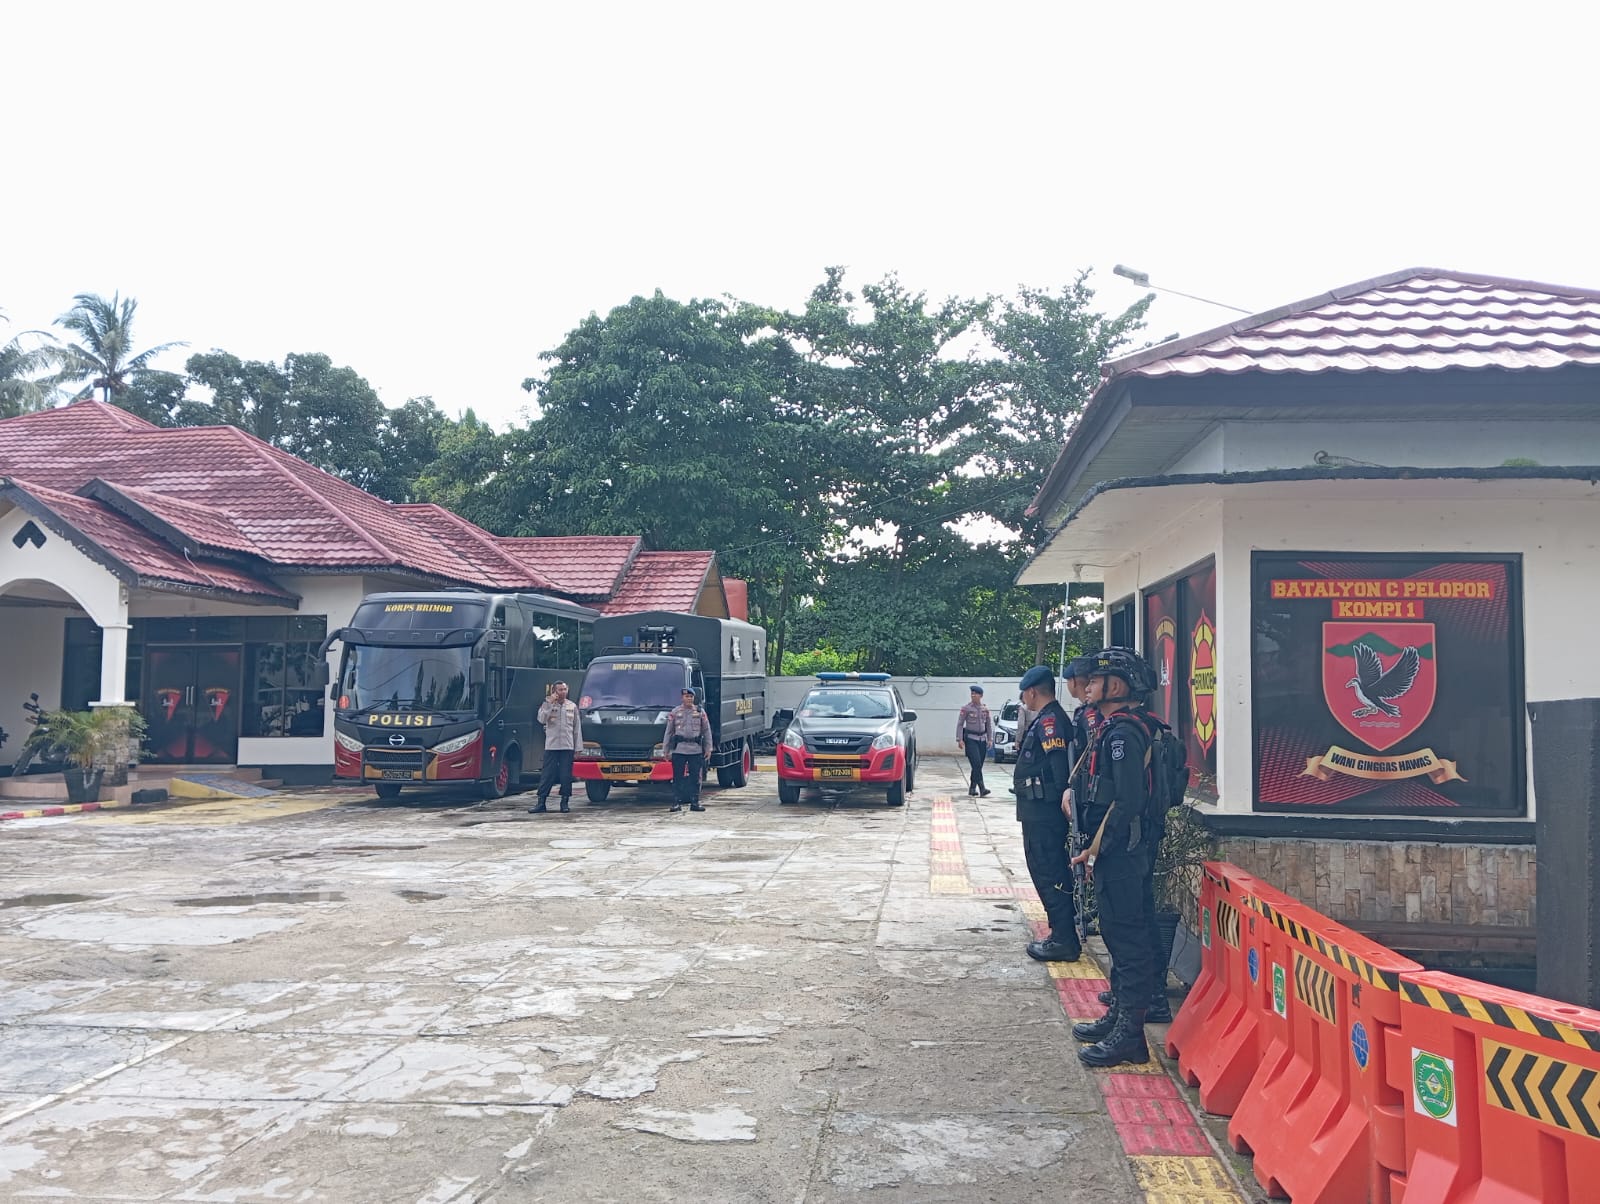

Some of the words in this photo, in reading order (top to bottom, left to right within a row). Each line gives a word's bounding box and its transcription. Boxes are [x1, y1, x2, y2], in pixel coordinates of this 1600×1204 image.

[1273, 581, 1381, 597] BATALYON
[1385, 582, 1399, 597] C
[1403, 581, 1490, 598] PELOPOR
[384, 604, 414, 612] KORPS
[416, 604, 453, 612] BRIMOB
[1338, 601, 1402, 617] KOMPI
[1406, 602, 1416, 617] 1
[368, 714, 432, 726] POLISI
[1331, 752, 1355, 769] WANI
[1357, 760, 1397, 772] GINGGAS
[1398, 755, 1432, 772] HAWAS
